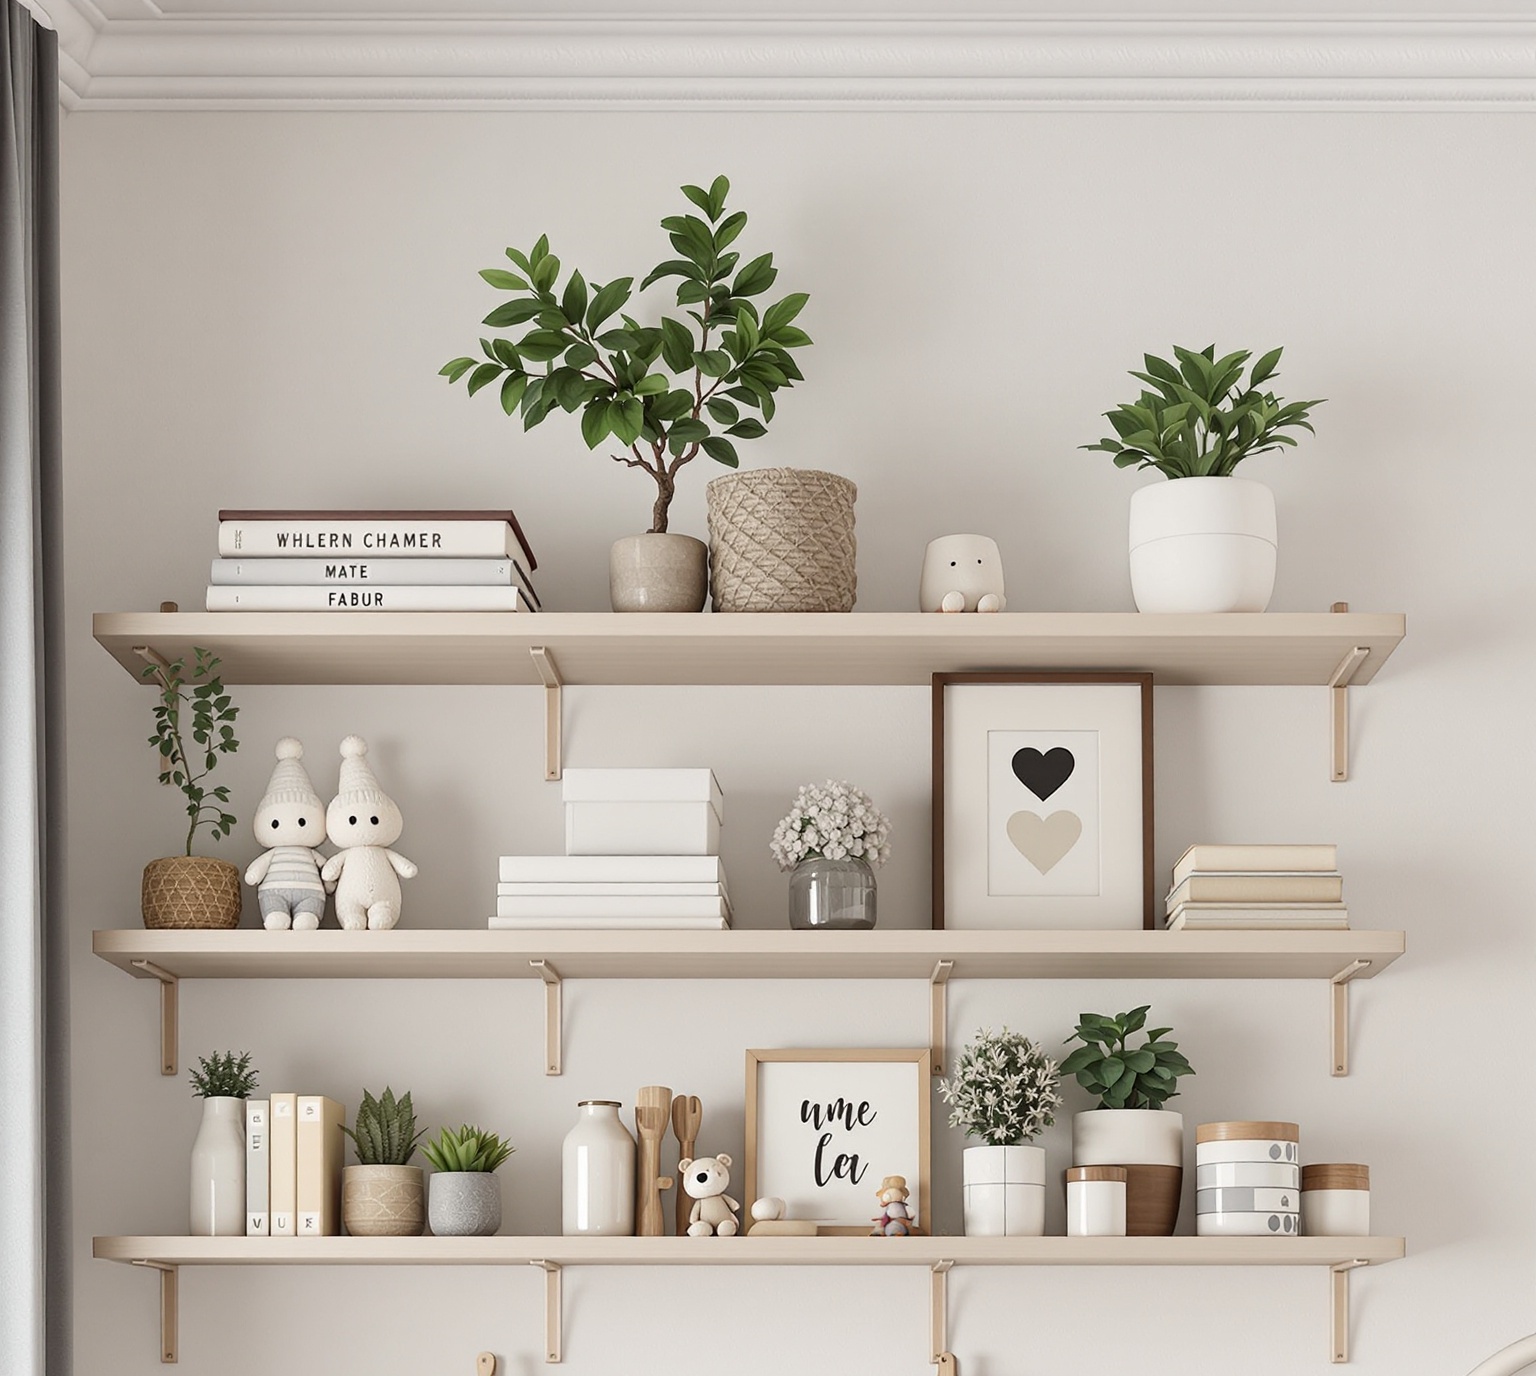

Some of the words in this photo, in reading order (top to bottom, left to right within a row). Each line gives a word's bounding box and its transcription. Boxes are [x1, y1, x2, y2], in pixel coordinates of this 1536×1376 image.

[277, 533, 352, 548] WHLERN
[363, 533, 442, 548] CHAMER
[325, 565, 368, 579] MATE
[328, 593, 384, 607] FABUR
[253, 1218, 262, 1229] V
[277, 1218, 286, 1229] U
